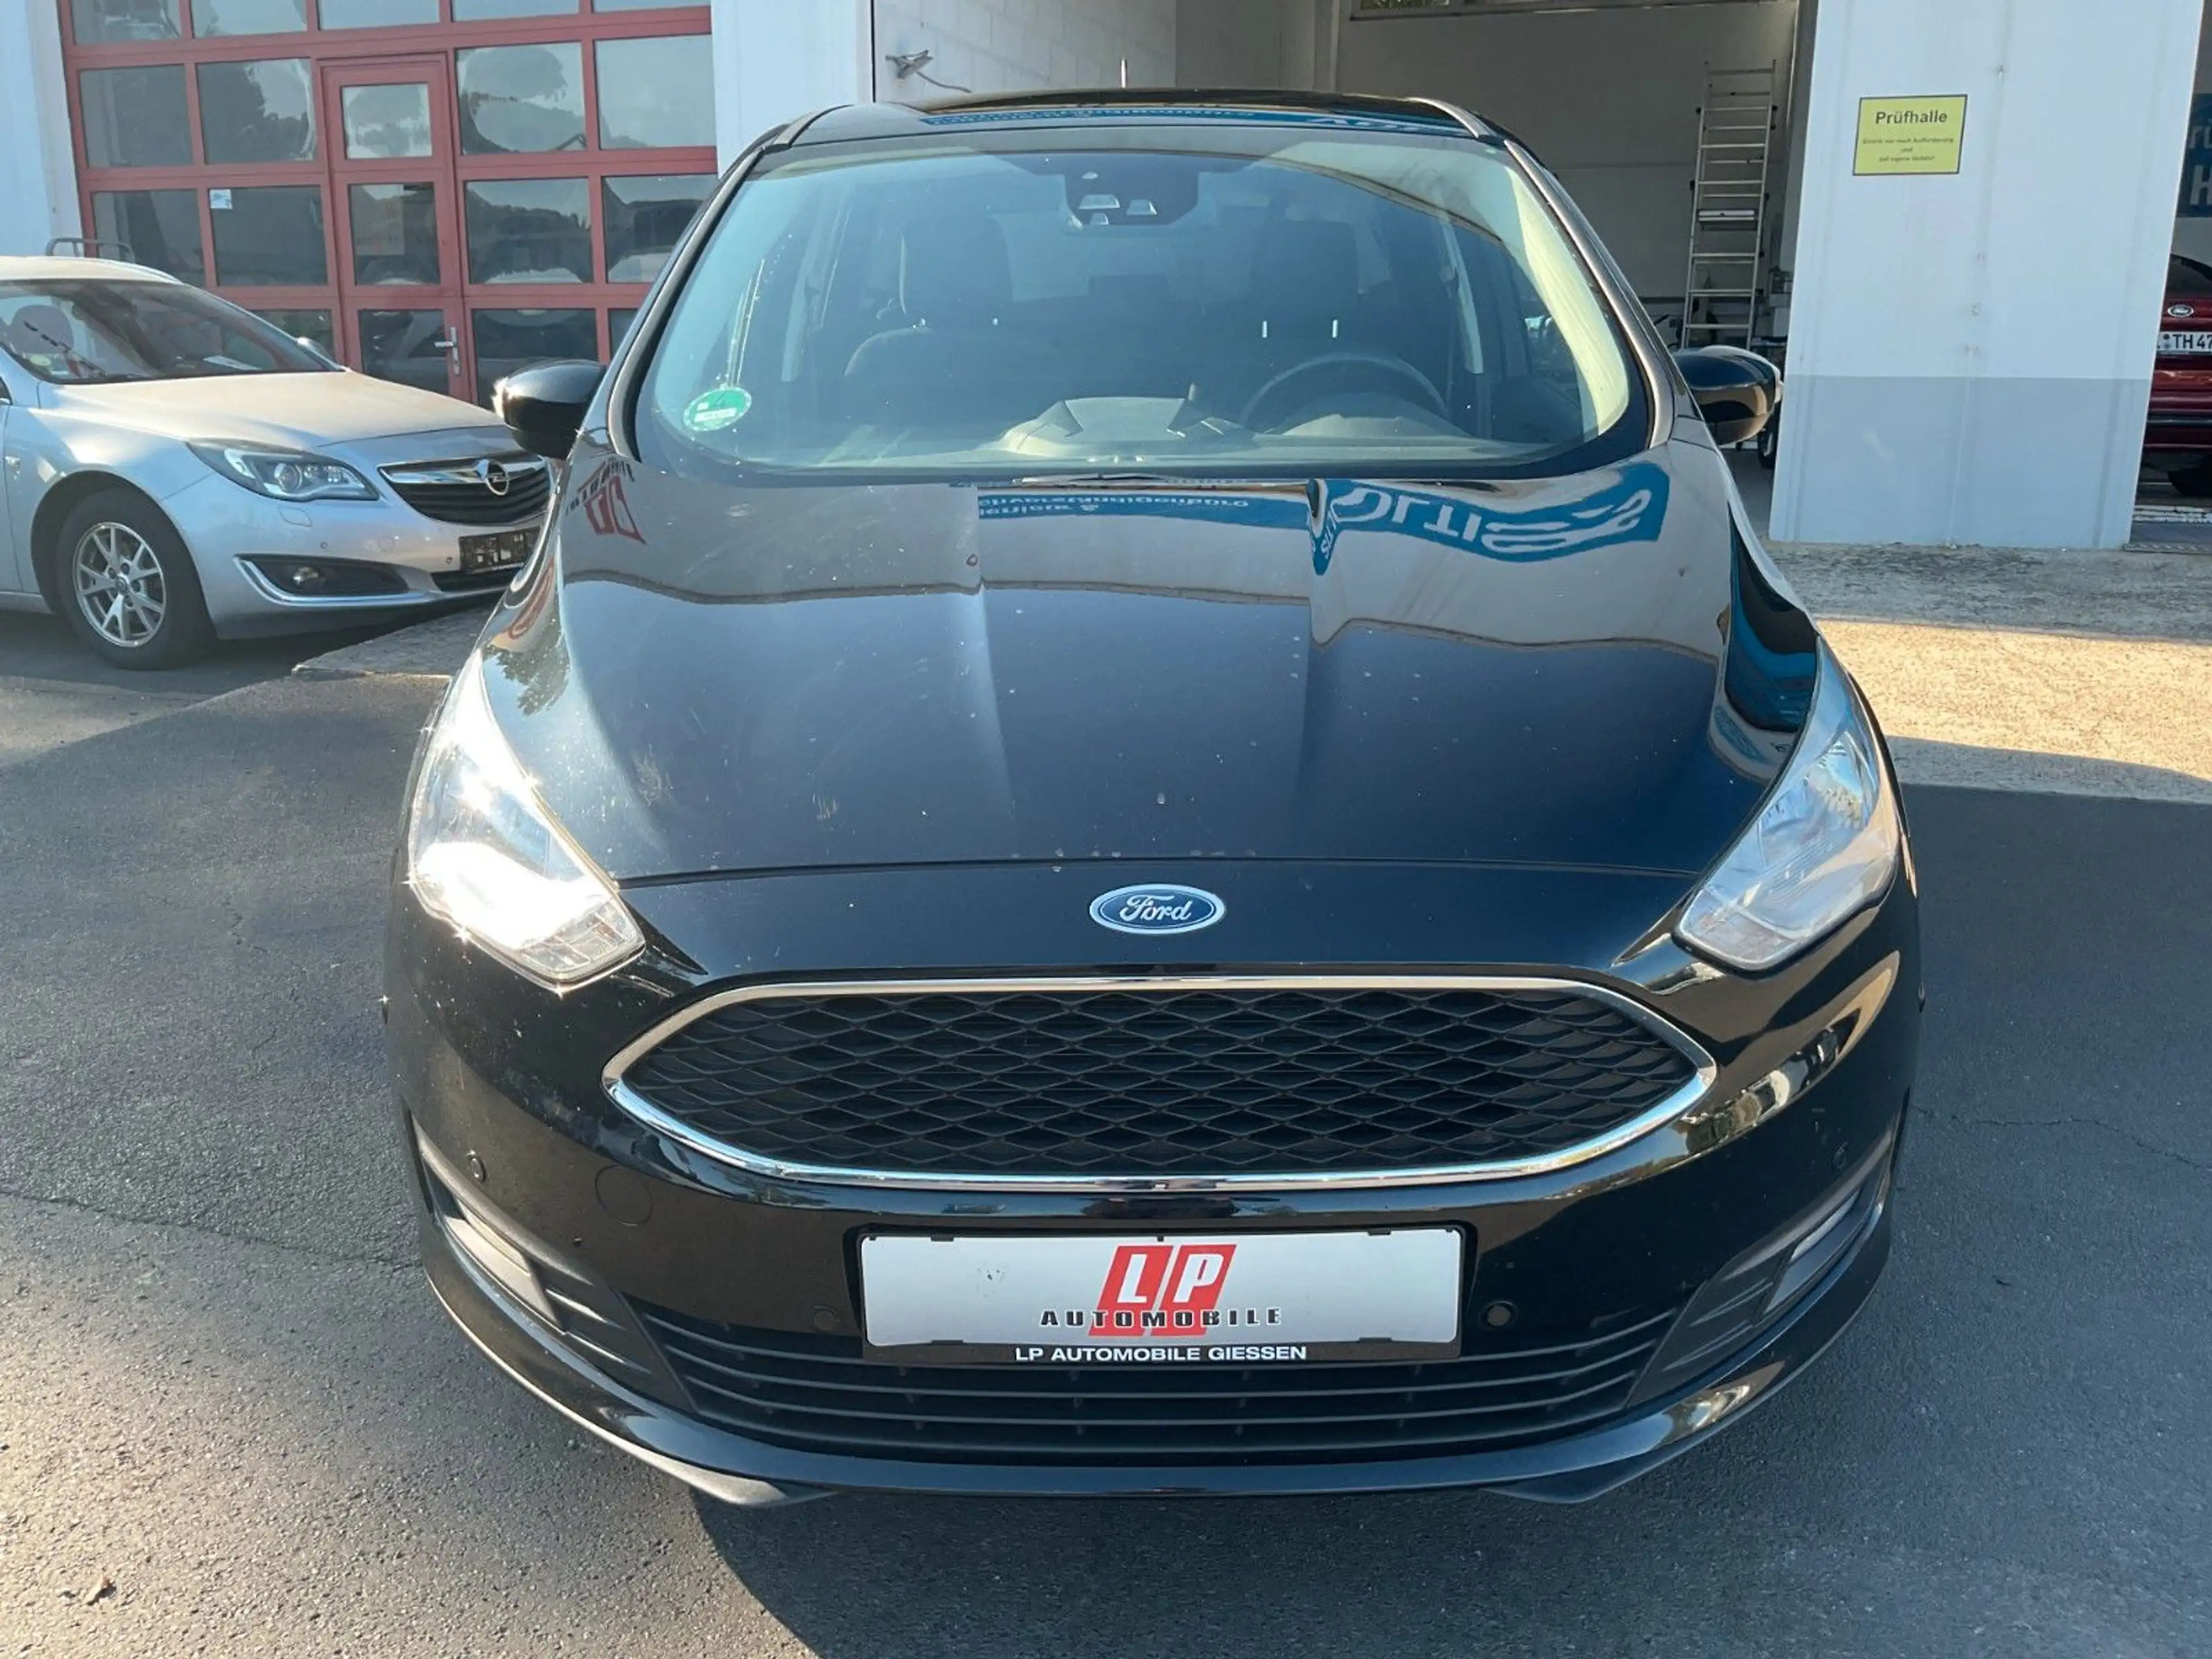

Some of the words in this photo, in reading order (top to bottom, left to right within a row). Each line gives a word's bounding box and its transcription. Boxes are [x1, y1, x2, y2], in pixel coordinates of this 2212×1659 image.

[1876, 110, 1948, 124] Prüfhalle
[2173, 334, 2194, 349] TH
[1120, 895, 1192, 921] Ford
[1117, 1253, 1225, 1303] LP
[1040, 1307, 1281, 1327] AUTOMOBILE
[1016, 1347, 1044, 1361] LP
[1050, 1347, 1200, 1361] AUTOMOBILE
[1208, 1346, 1306, 1361] GIESSEN
